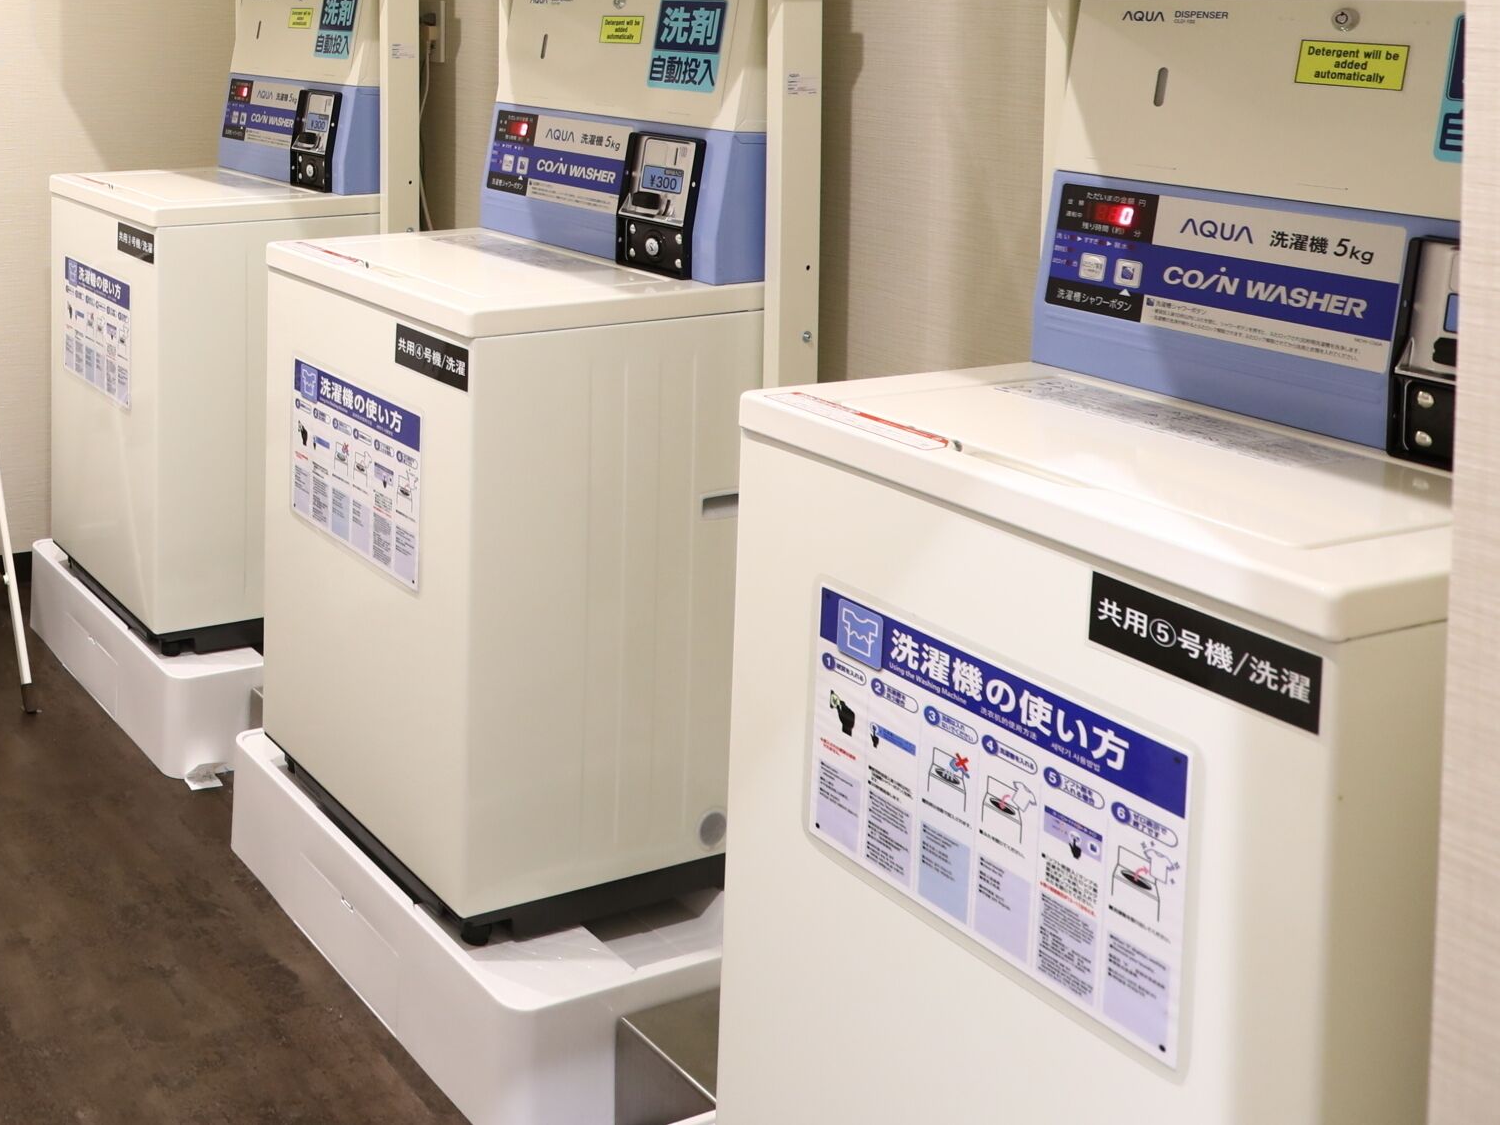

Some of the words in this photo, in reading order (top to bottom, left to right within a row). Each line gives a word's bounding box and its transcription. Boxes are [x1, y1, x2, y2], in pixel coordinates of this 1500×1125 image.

[604, 19, 626, 27] Detergent
[660, 6, 721, 46] 洗剤
[1122, 10, 1164, 23] AQUA
[1174, 10, 1229, 20] DISPENSER
[315, 34, 350, 56] 自動投入
[1307, 45, 1360, 59] Detergent
[1363, 47, 1381, 60] will
[1385, 50, 1400, 61] be
[650, 55, 715, 87] 自動投入
[1334, 60, 1368, 71] added
[1313, 70, 1385, 84] automatically
[268, 115, 295, 129] WASHER
[545, 128, 575, 143] AQUA
[604, 135, 621, 152] 5kg
[569, 165, 616, 184] WASHER
[650, 174, 677, 191] ¥300
[1179, 218, 1254, 245] AQUA
[1269, 230, 1329, 255] 洗濯機
[1333, 238, 1375, 266] 5kg
[1056, 287, 1132, 312] 洗濯槽シャワーボタン
[1246, 281, 1368, 320] WASHER
[319, 375, 403, 434] 洗濯機の使い方
[1097, 597, 1311, 705] 共用⑤号機/洗濯
[888, 661, 904, 676] Using
[905, 669, 915, 680] the
[916, 674, 942, 694] Washing
[941, 686, 968, 706] Machine
[890, 628, 1130, 771] 洗濯機の使い方
[1048, 771, 1057, 783] 5
[1116, 809, 1126, 820] 6
